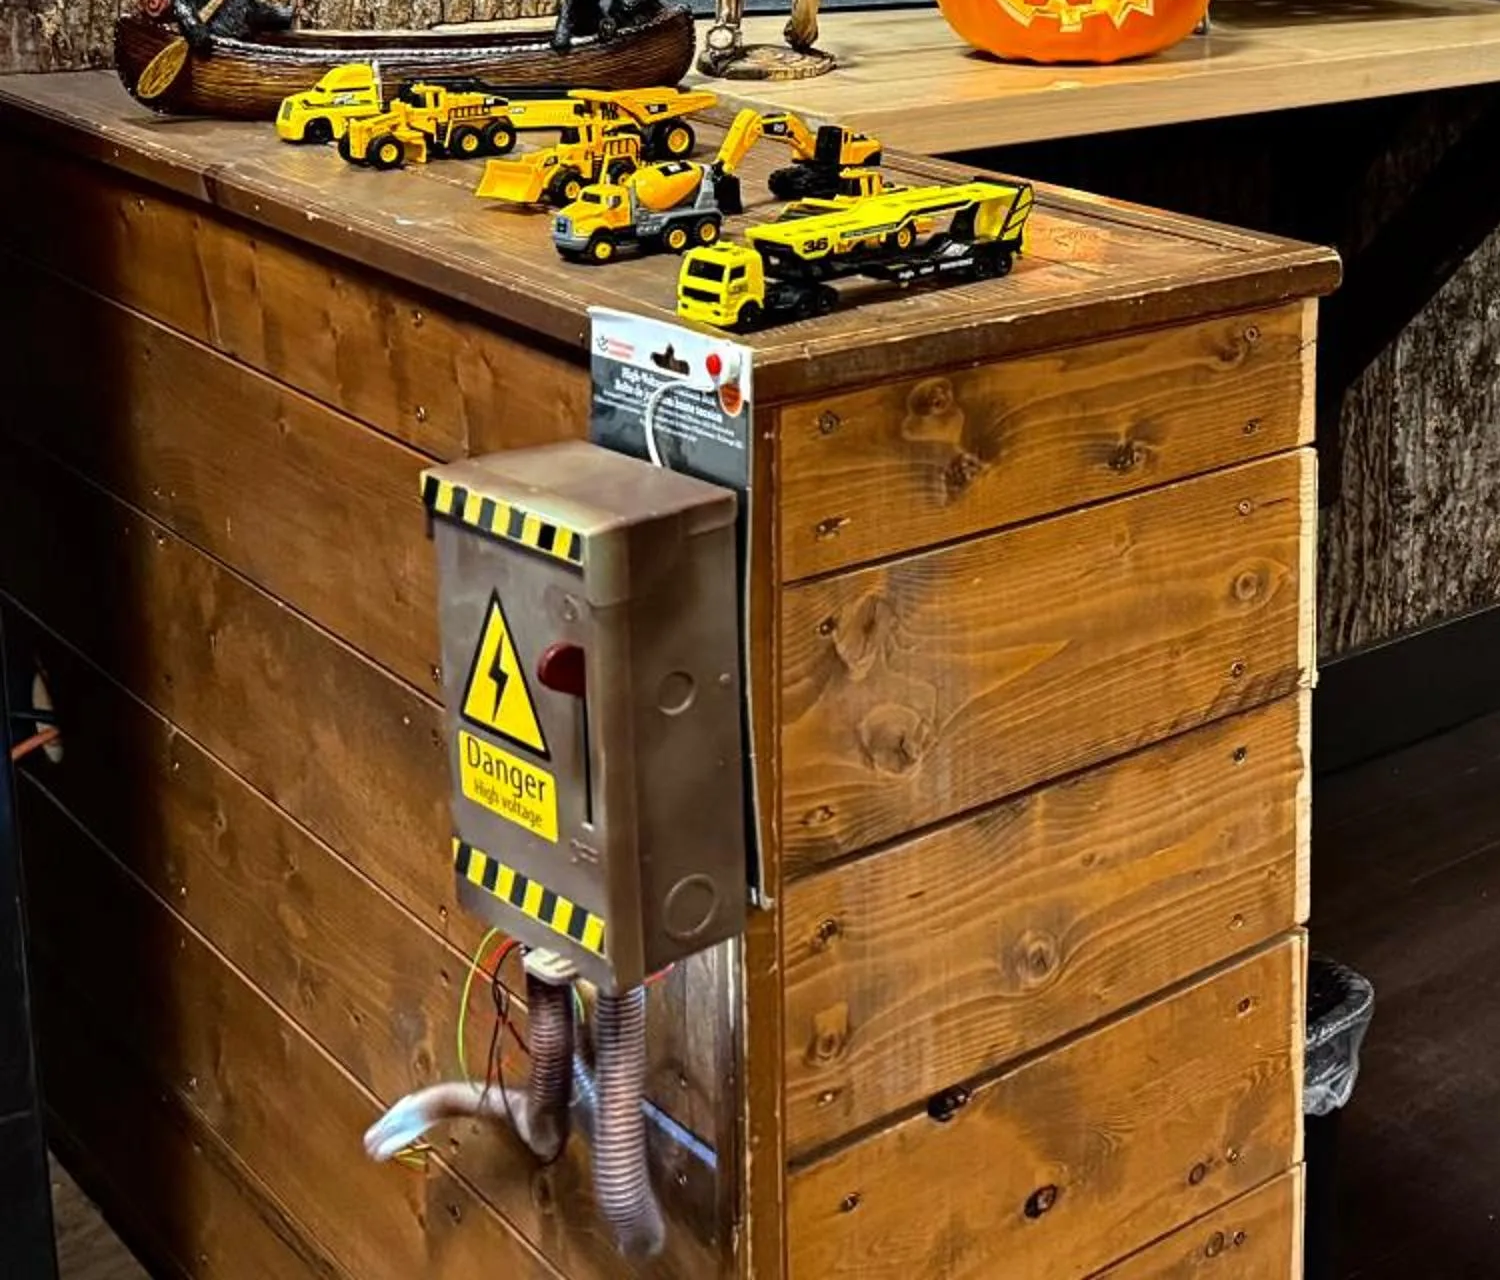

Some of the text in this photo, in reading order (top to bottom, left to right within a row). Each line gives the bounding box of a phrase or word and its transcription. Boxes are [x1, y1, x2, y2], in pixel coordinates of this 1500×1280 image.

[803, 236, 829, 254] 36
[467, 735, 546, 802] Danger
[474, 777, 543, 828] High voltage
